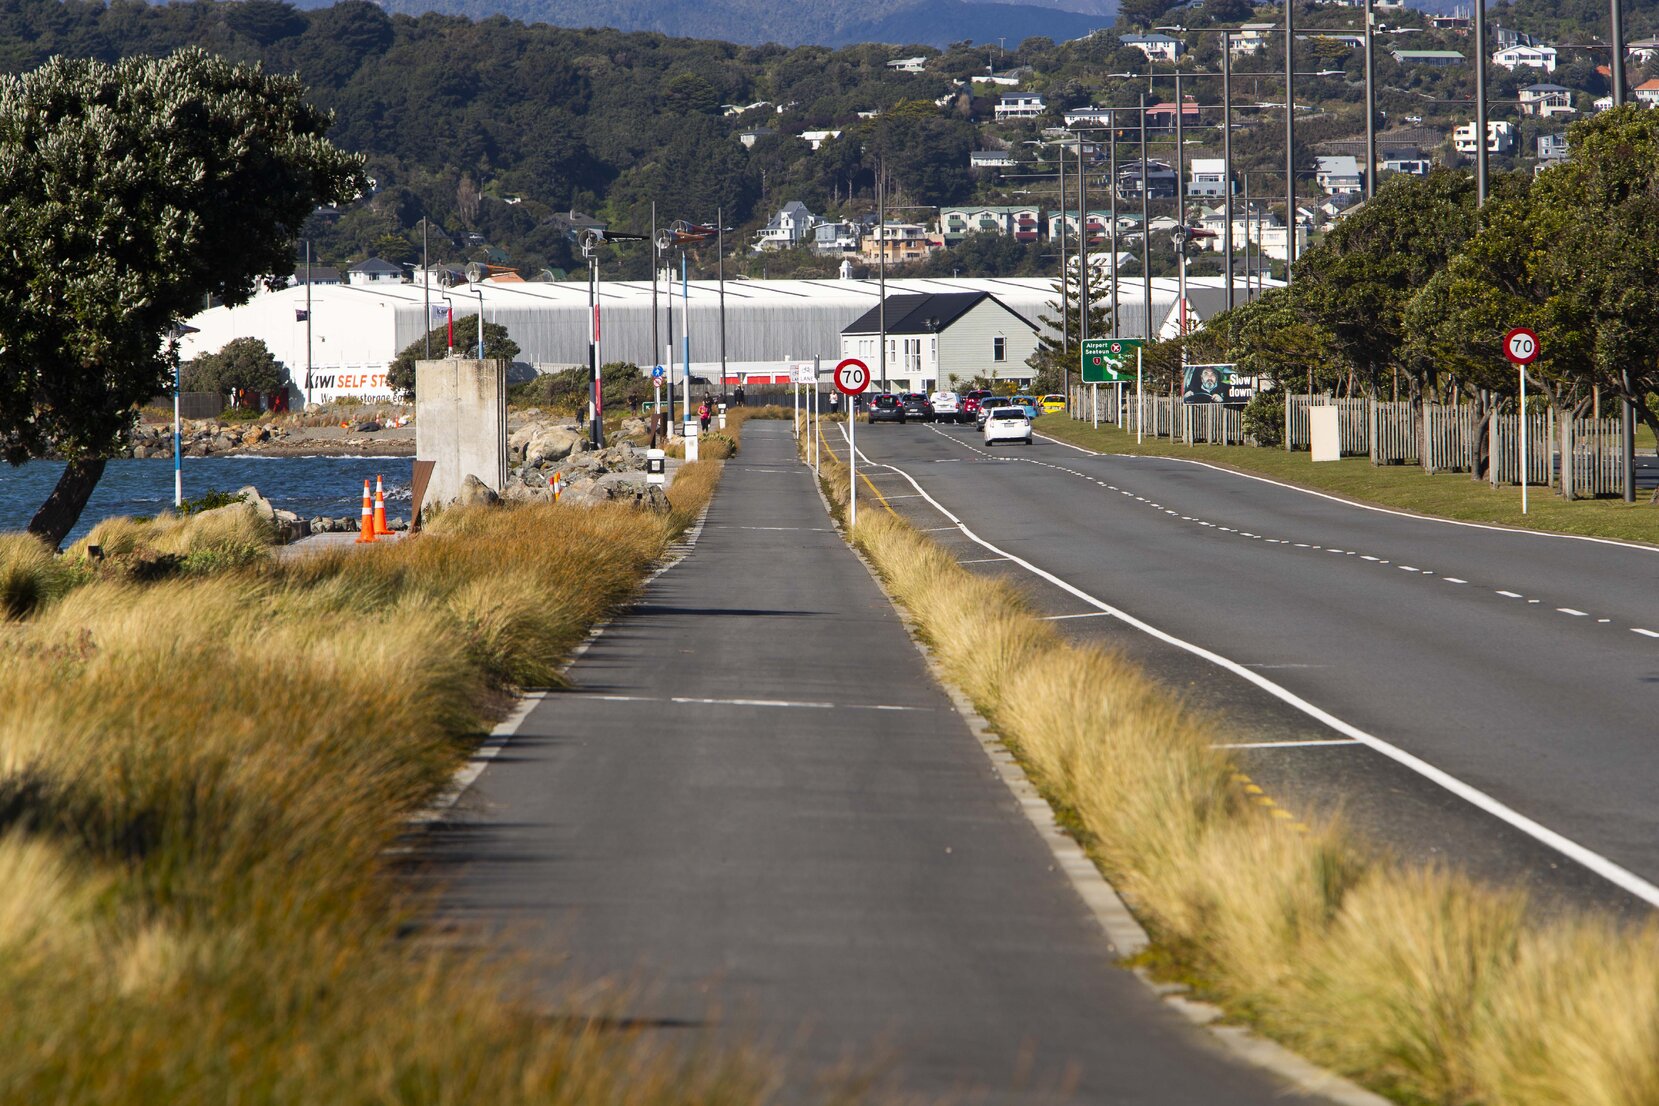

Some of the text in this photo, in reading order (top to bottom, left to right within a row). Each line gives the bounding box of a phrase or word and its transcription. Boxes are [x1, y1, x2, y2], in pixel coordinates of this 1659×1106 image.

[1513, 340, 1532, 353] 70
[337, 374, 368, 388] SELF
[842, 370, 863, 383] 70
[1229, 373, 1251, 386] Slow
[321, 393, 332, 403] We
[1228, 386, 1252, 397] down
